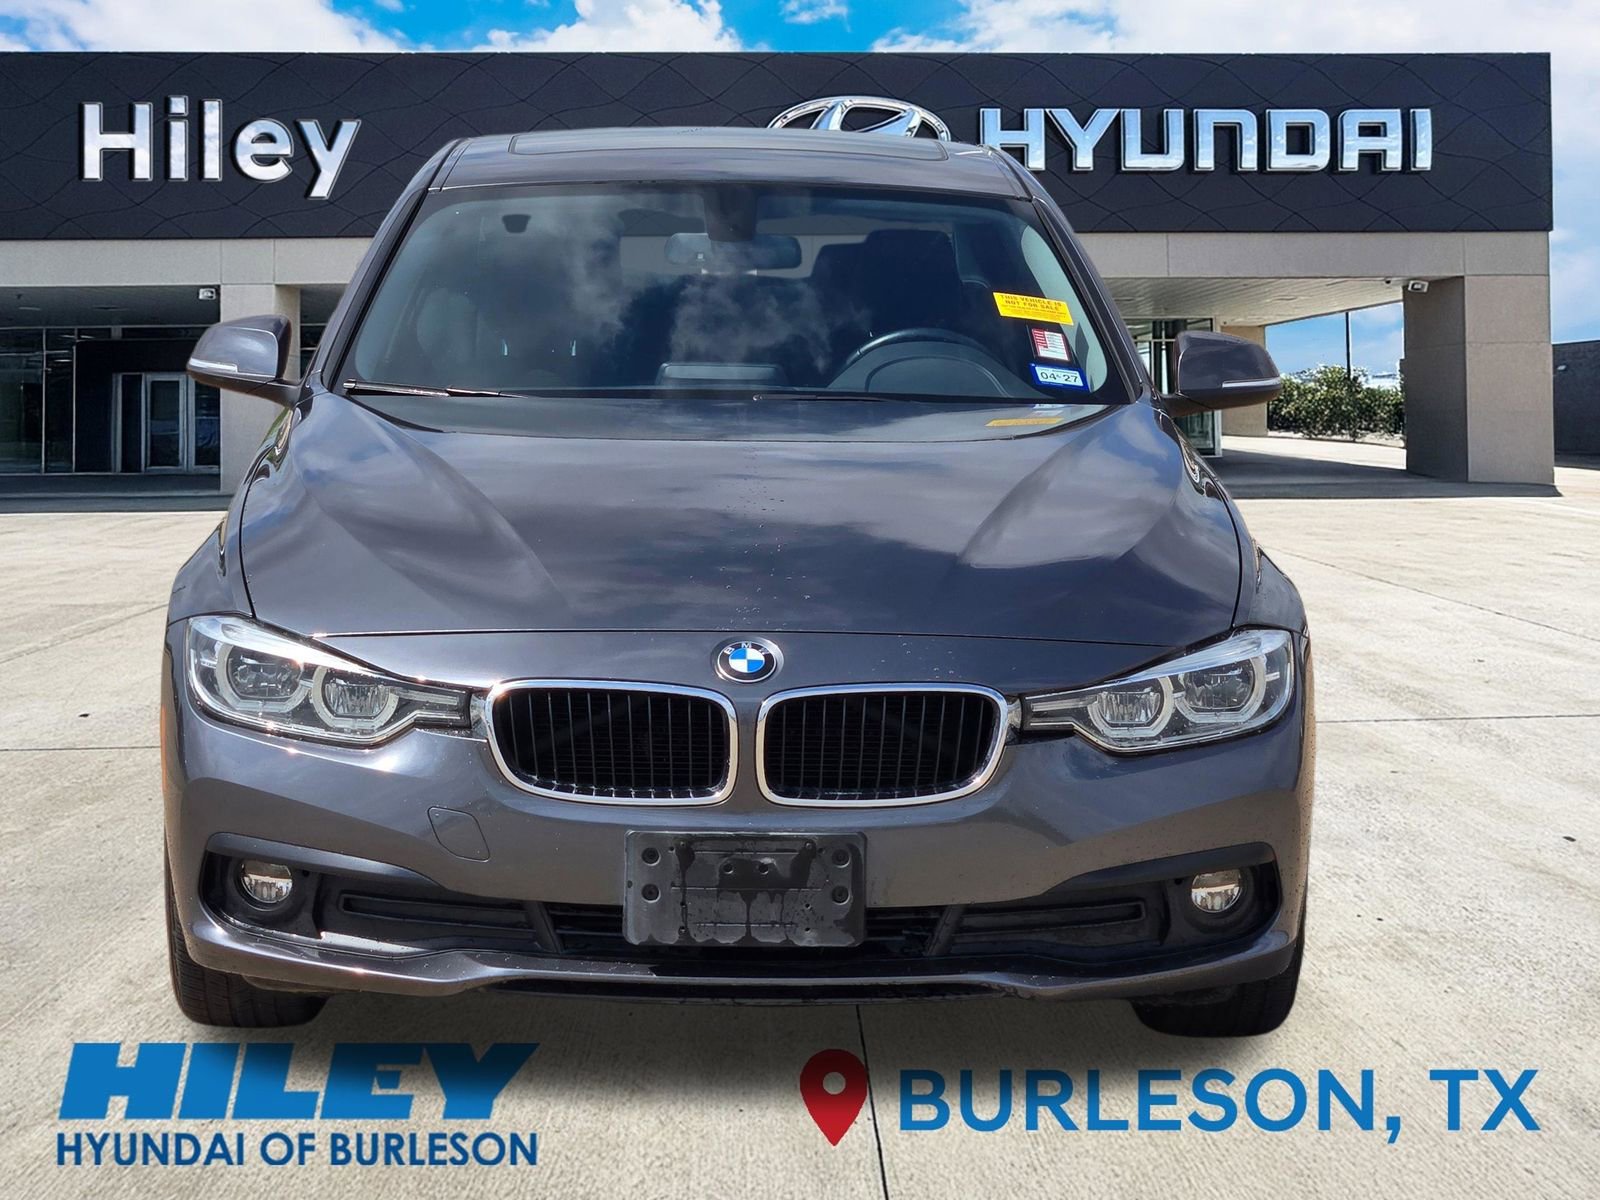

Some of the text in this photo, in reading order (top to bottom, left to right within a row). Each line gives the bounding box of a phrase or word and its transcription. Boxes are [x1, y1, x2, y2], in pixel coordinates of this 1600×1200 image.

[81, 94, 361, 199] Hiley
[979, 107, 1432, 172] HYUNDAI
[1020, 297, 1051, 305] VEHICLE
[723, 641, 770, 655] BMW
